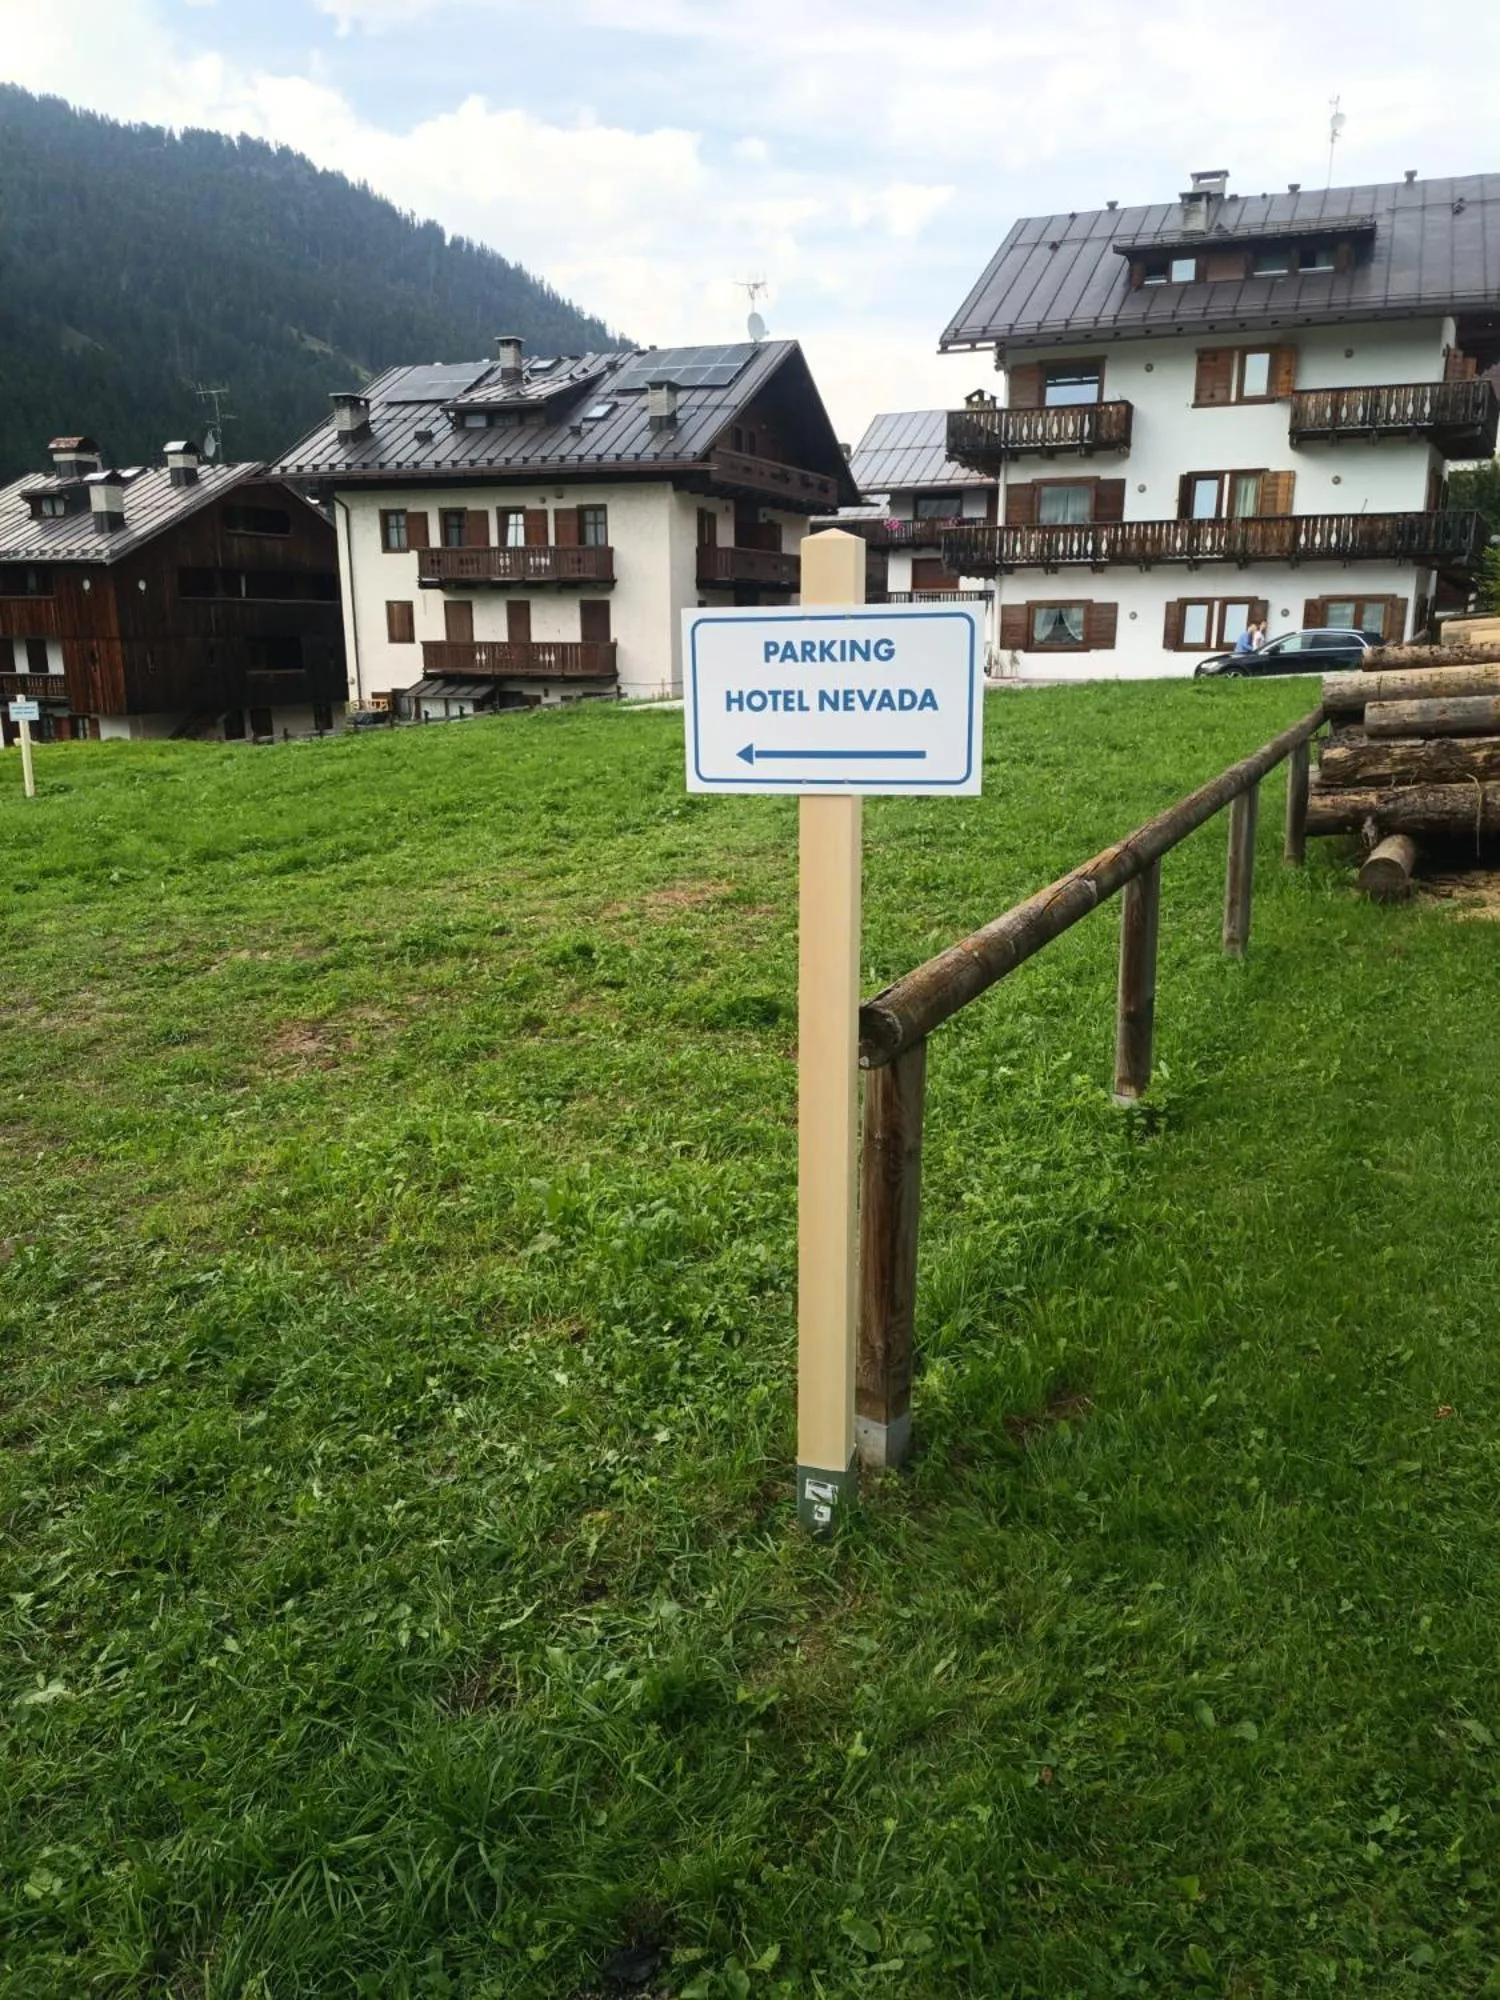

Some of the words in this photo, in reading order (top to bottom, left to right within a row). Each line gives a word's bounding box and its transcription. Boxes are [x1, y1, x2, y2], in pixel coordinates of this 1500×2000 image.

[763, 638, 896, 663] PARKING
[725, 689, 810, 712] HOTEL
[818, 688, 939, 711] NEVADA
